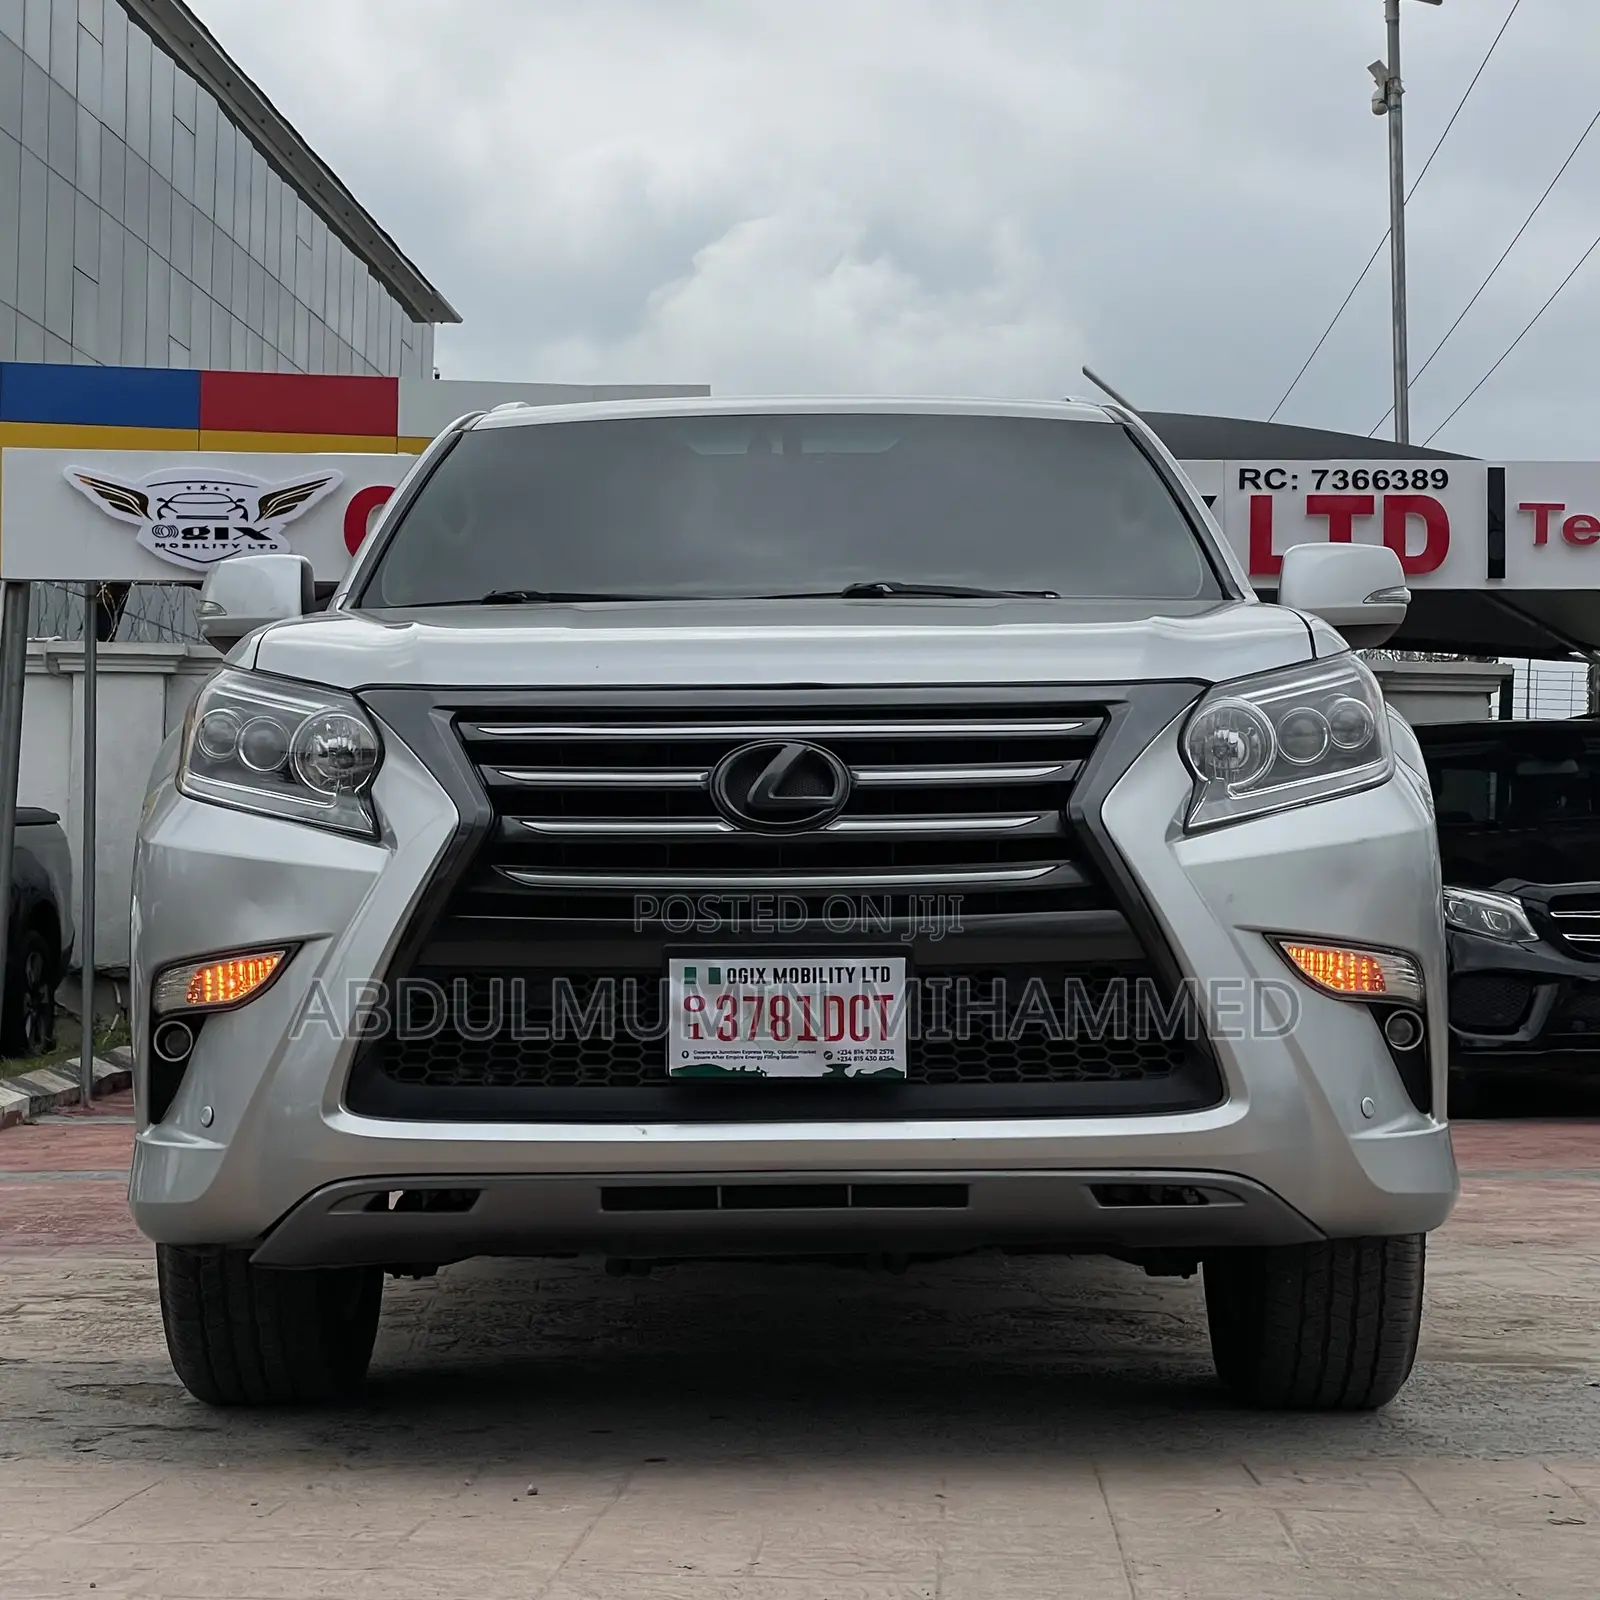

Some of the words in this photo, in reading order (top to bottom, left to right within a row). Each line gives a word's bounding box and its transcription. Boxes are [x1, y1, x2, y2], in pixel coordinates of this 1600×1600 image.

[1238, 468, 1299, 490] RC:
[1311, 468, 1449, 491] 7366389
[1249, 494, 1450, 576] LTD
[154, 542, 241, 550] MOBILITY
[726, 967, 767, 985] OGIX
[772, 966, 857, 985] MOBILITY
[861, 966, 891, 983] LTD
